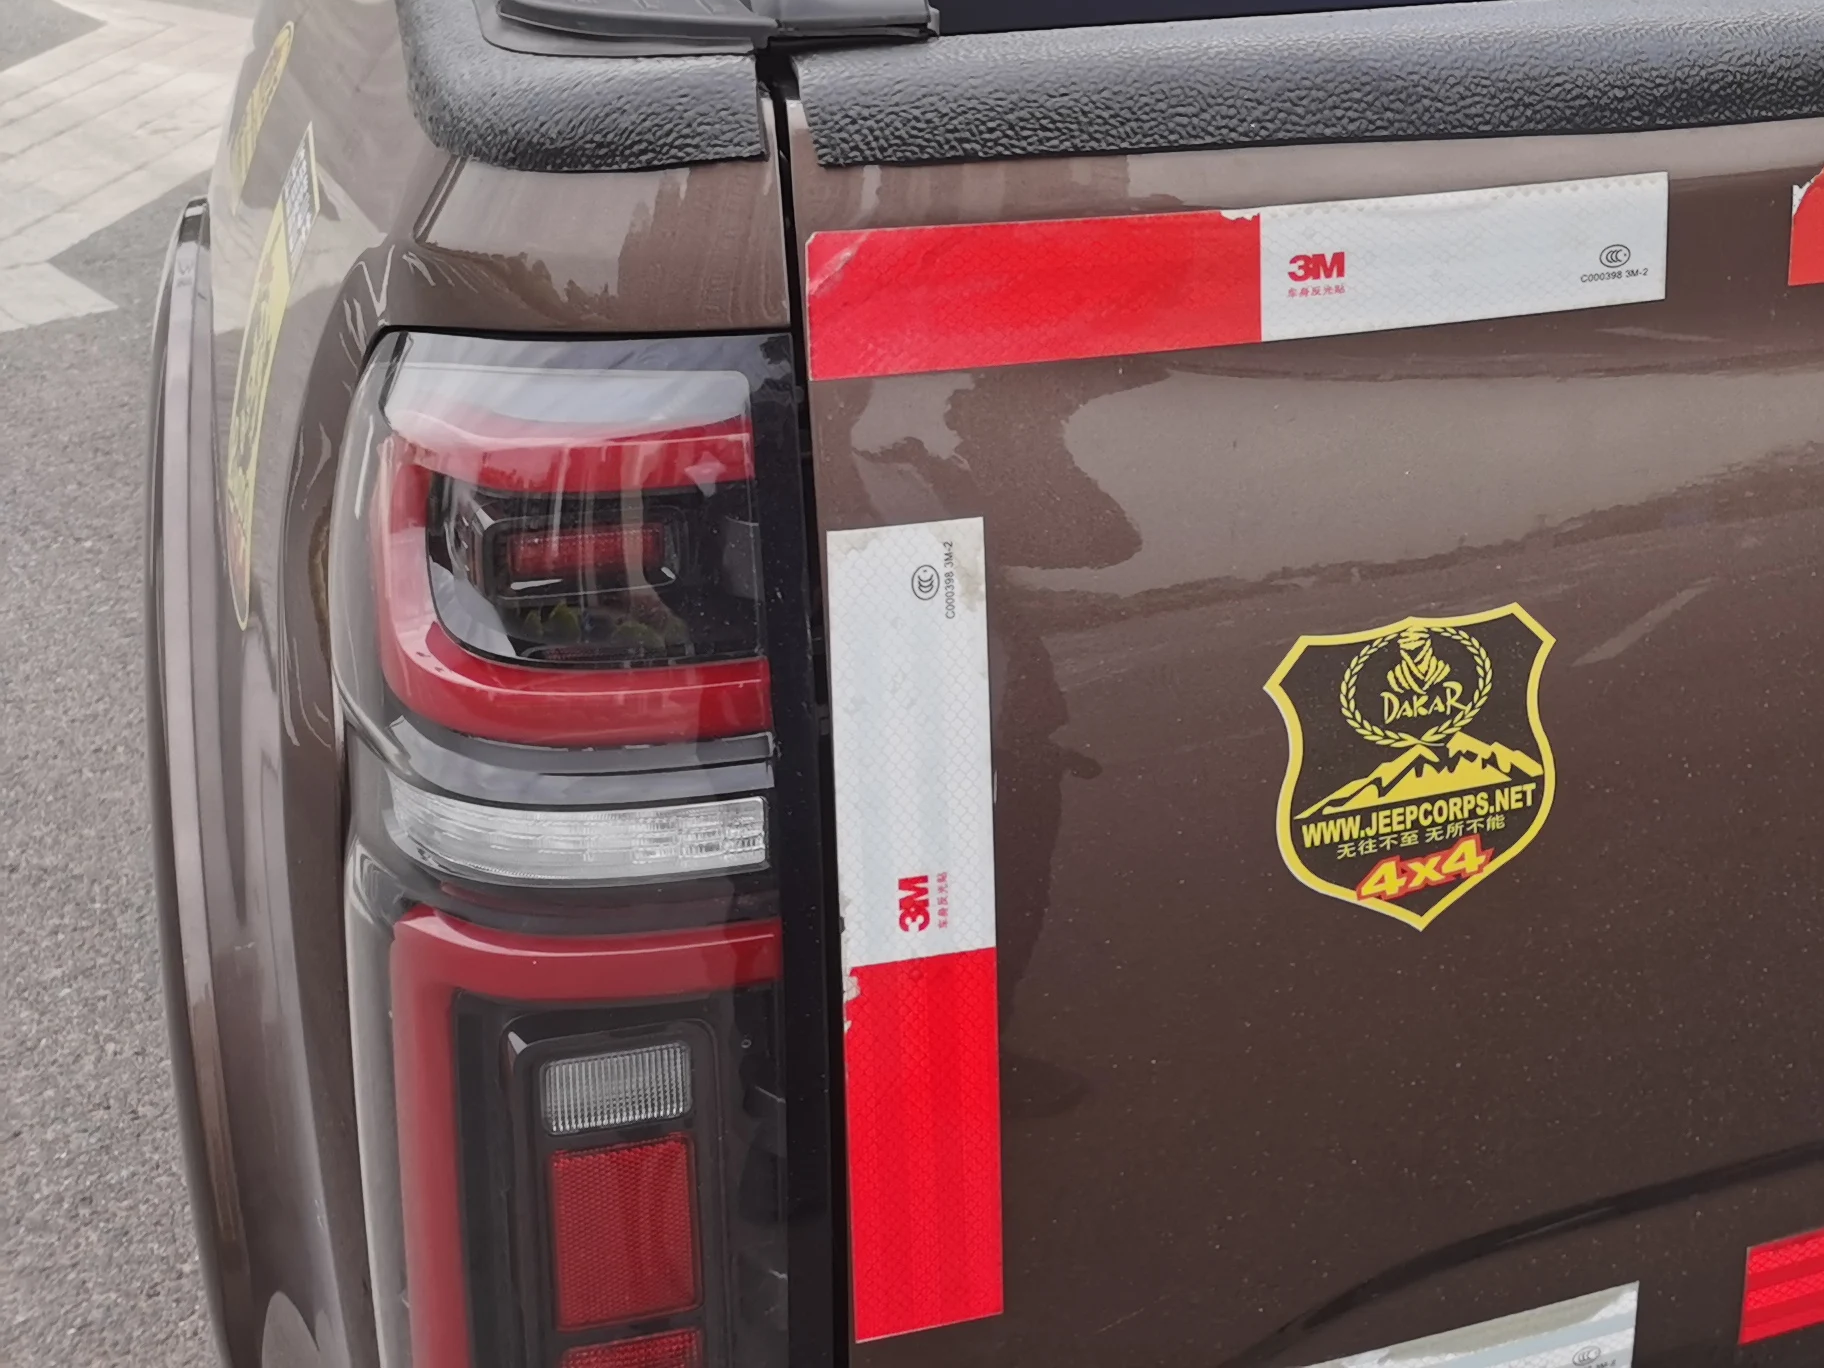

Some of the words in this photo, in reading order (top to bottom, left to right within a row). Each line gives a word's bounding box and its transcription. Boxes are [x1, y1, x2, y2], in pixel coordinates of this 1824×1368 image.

[1288, 252, 1345, 282] 3M
[1580, 271, 1623, 283] C000398
[1625, 268, 1649, 278] 3M-2
[943, 541, 954, 568] 3M-2
[944, 572, 955, 619] C000398
[1380, 681, 1470, 724] DAKAR
[1302, 783, 1537, 848] WWW.JEEPCORPS.NET
[1336, 830, 1419, 860] 无往不至
[1425, 814, 1505, 843] 无所不能
[1359, 837, 1488, 898] 4x4
[898, 875, 930, 932] 3M
